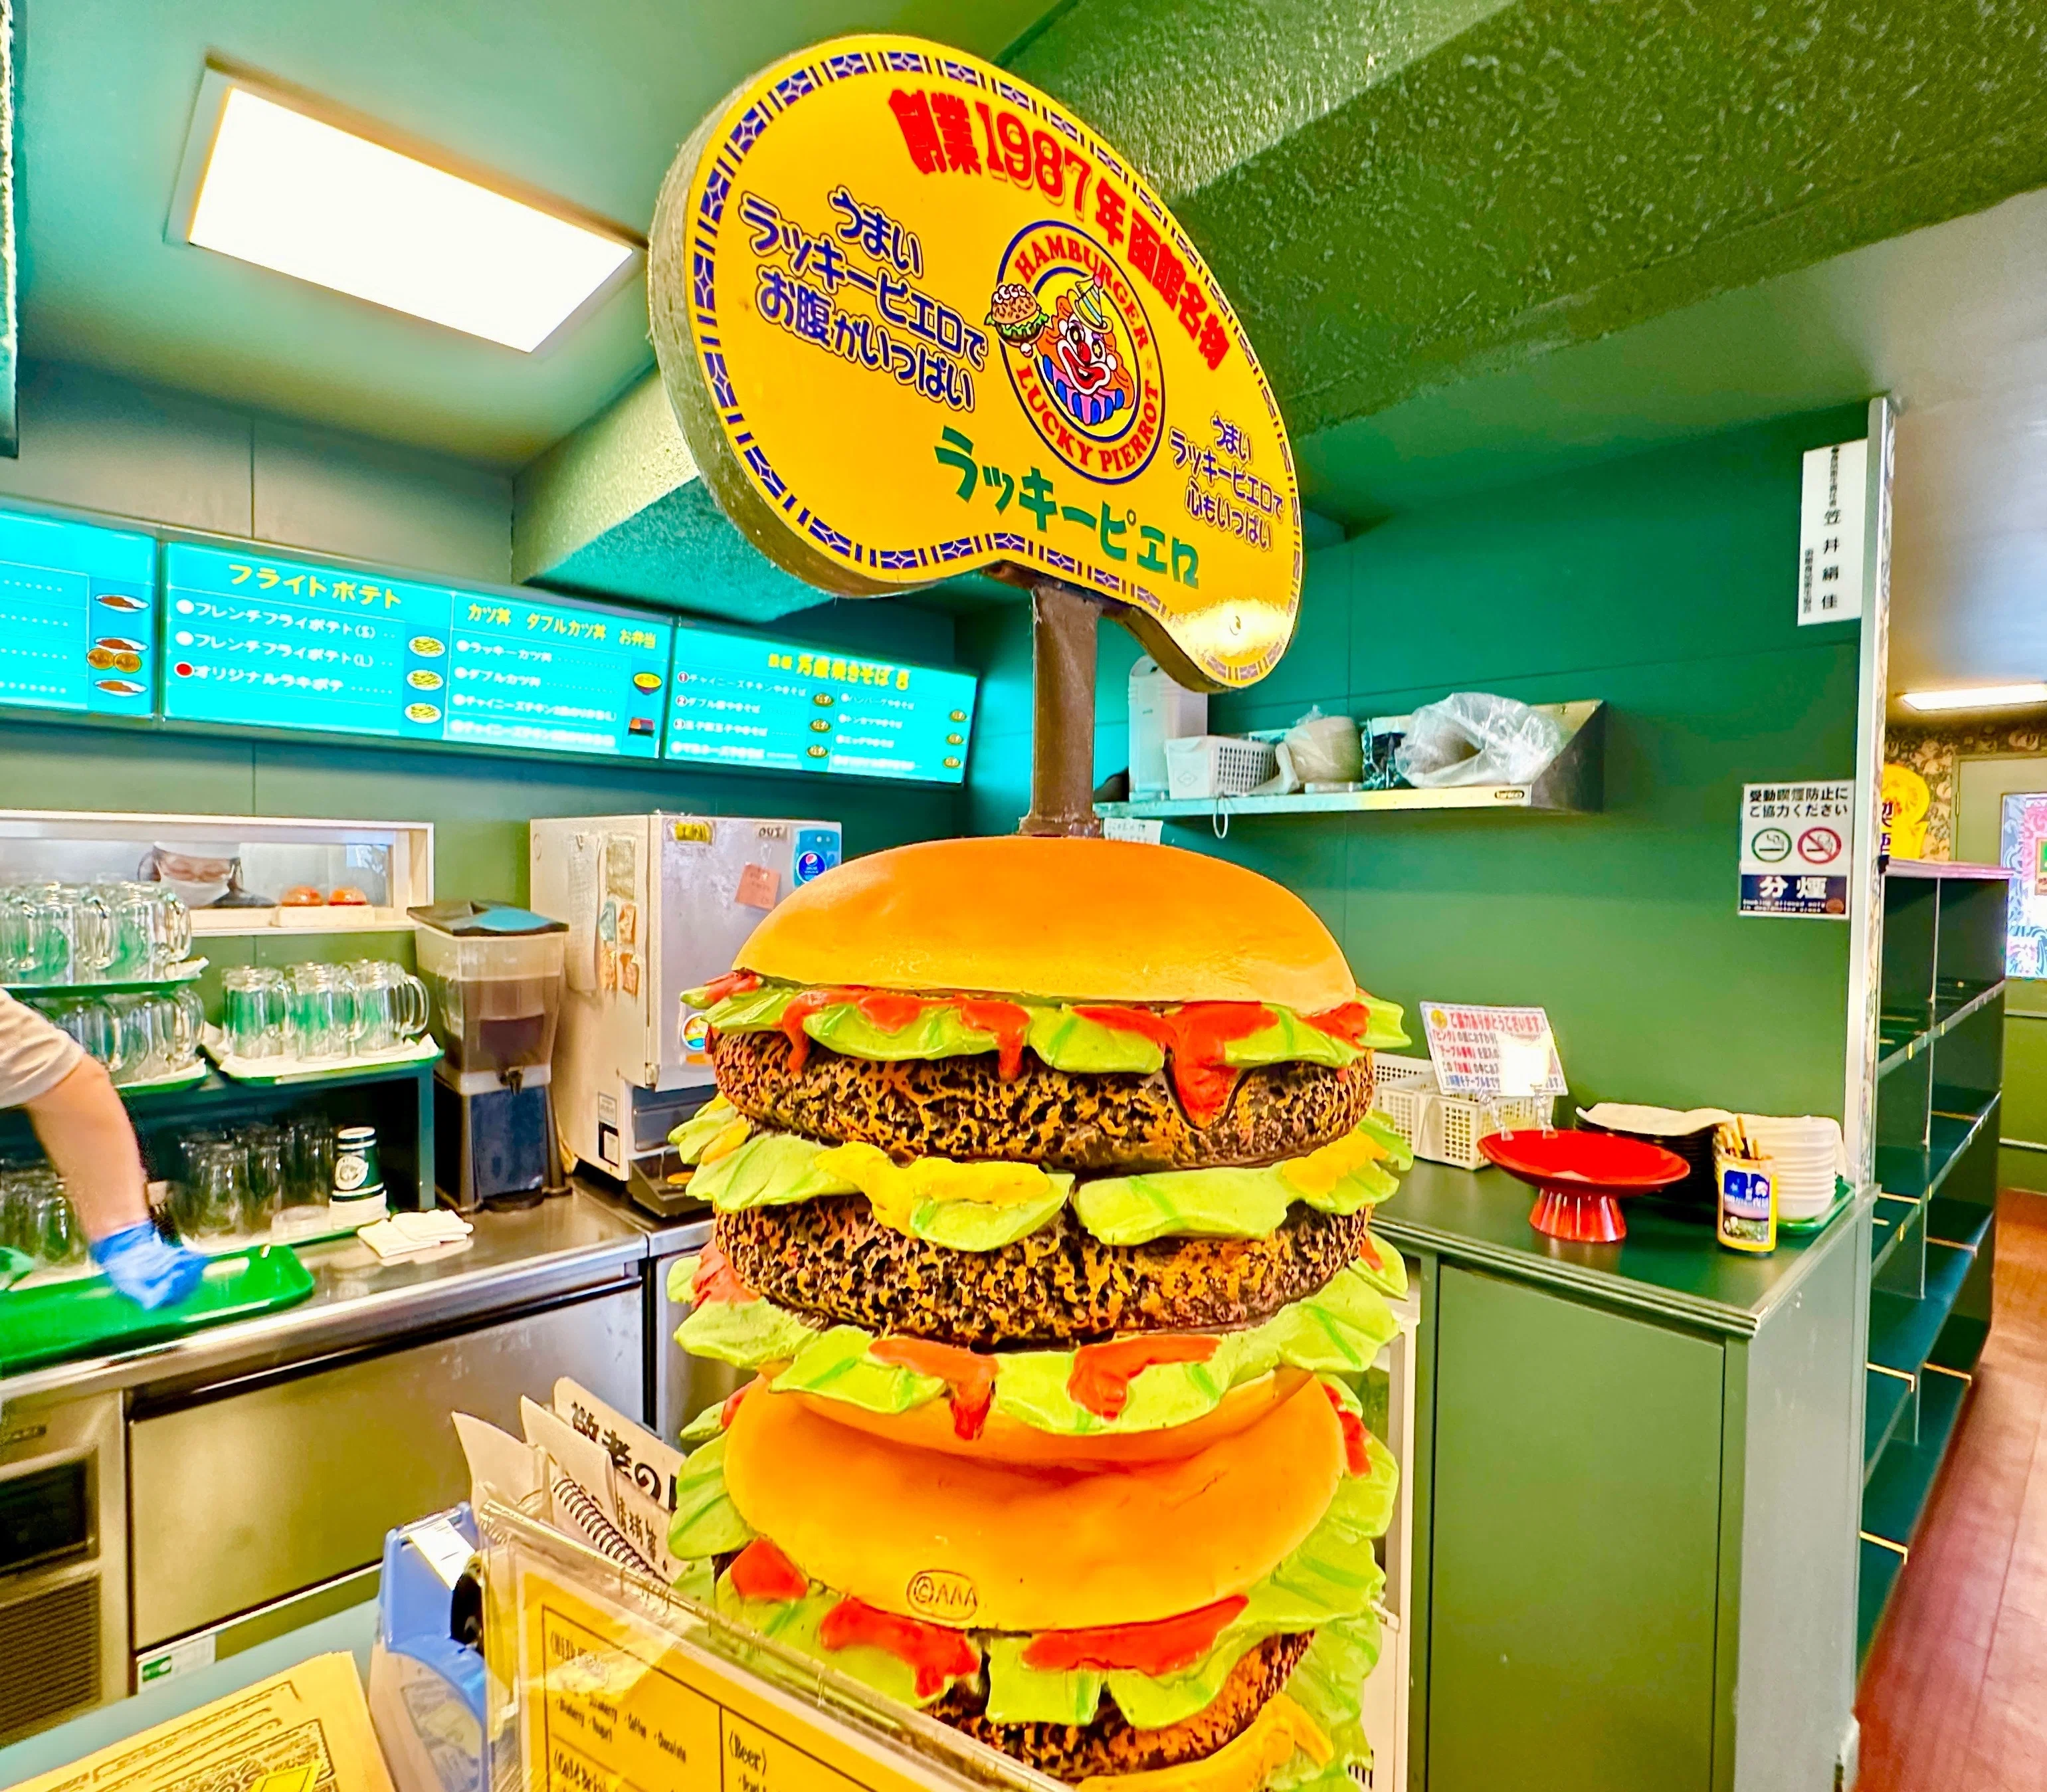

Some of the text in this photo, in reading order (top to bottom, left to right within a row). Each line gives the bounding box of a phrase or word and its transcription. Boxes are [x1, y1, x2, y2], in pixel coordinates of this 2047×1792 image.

[829, 187, 923, 277] うまい
[757, 266, 975, 411] お腹がいっぱい
[1015, 234, 1149, 352] HAMBURGER
[1016, 363, 1159, 473] LUCKY PIERROT
[1213, 412, 1252, 462] うまい
[934, 425, 1199, 589] ラッキーピエロ
[1185, 479, 1272, 551] 心もいっぱい
[1750, 803, 1848, 818] ご協力ください
